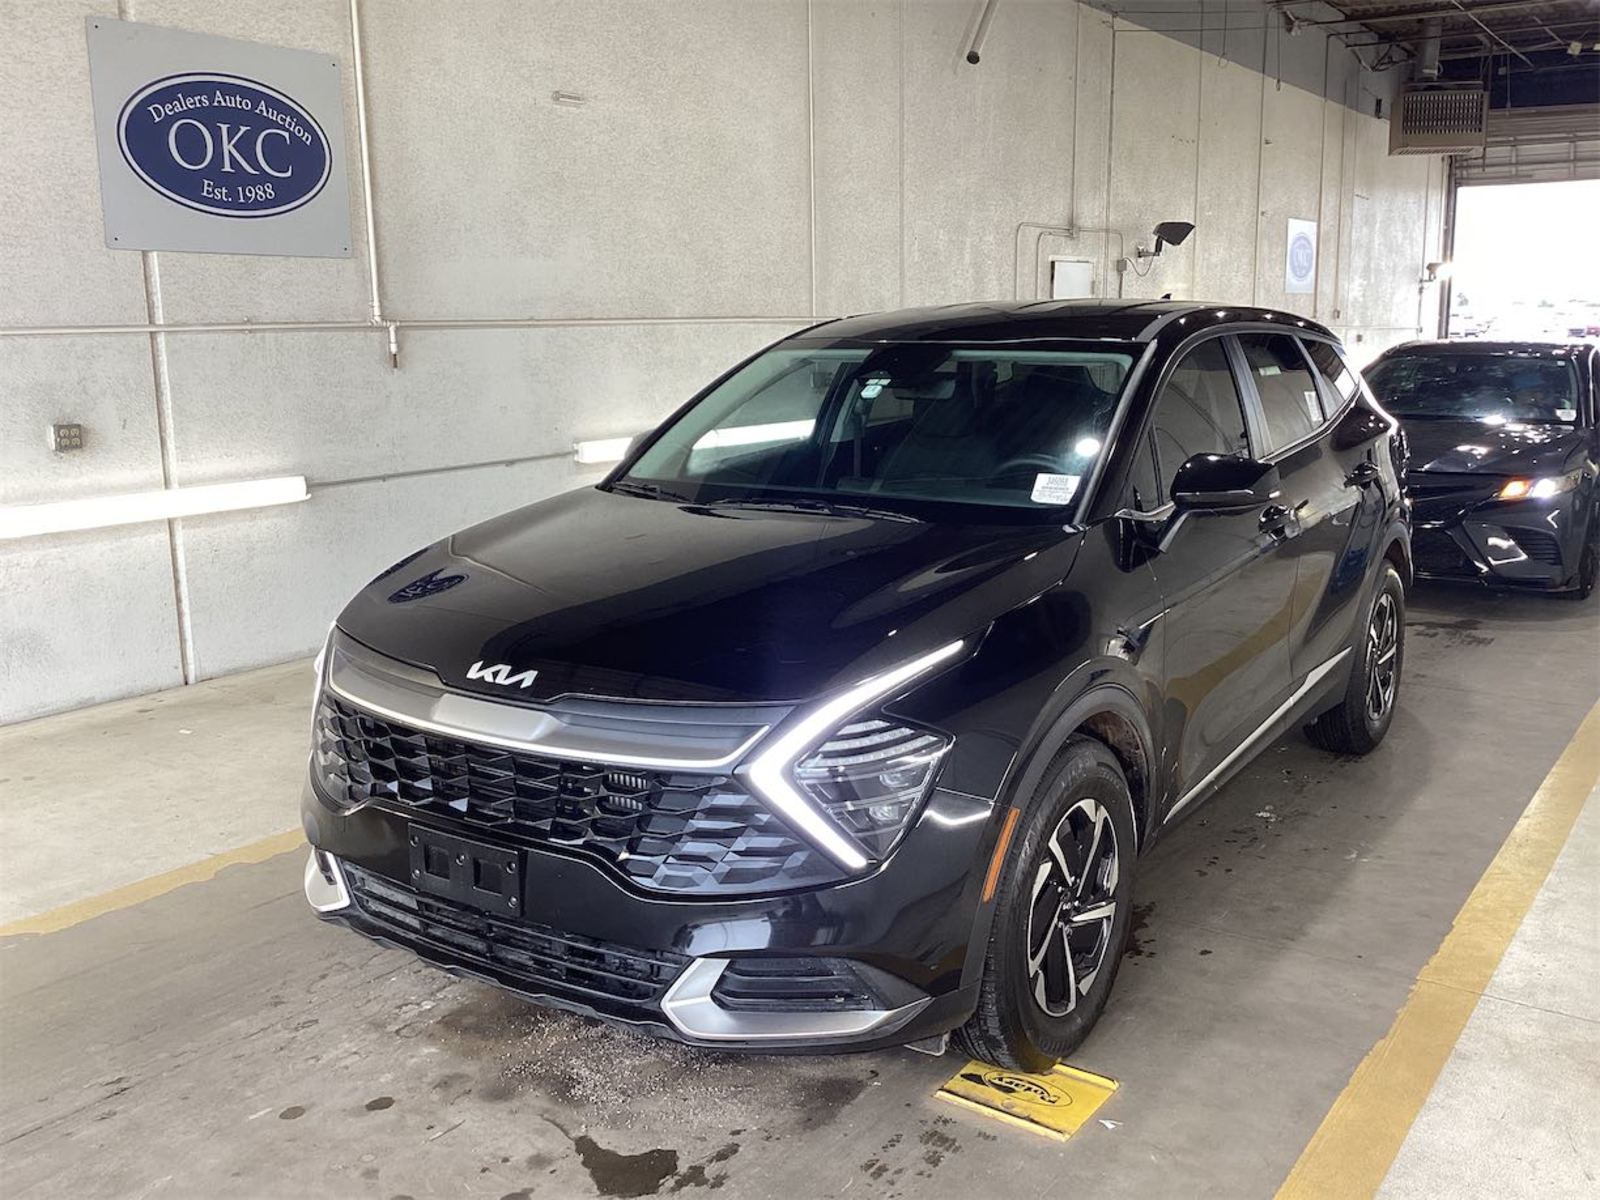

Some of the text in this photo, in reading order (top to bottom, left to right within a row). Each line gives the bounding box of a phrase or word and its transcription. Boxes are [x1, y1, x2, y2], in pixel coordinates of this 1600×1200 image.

[147, 90, 312, 146] Dealers Auto Auction
[168, 118, 293, 178] OKC
[201, 179, 275, 204] Est. 1988
